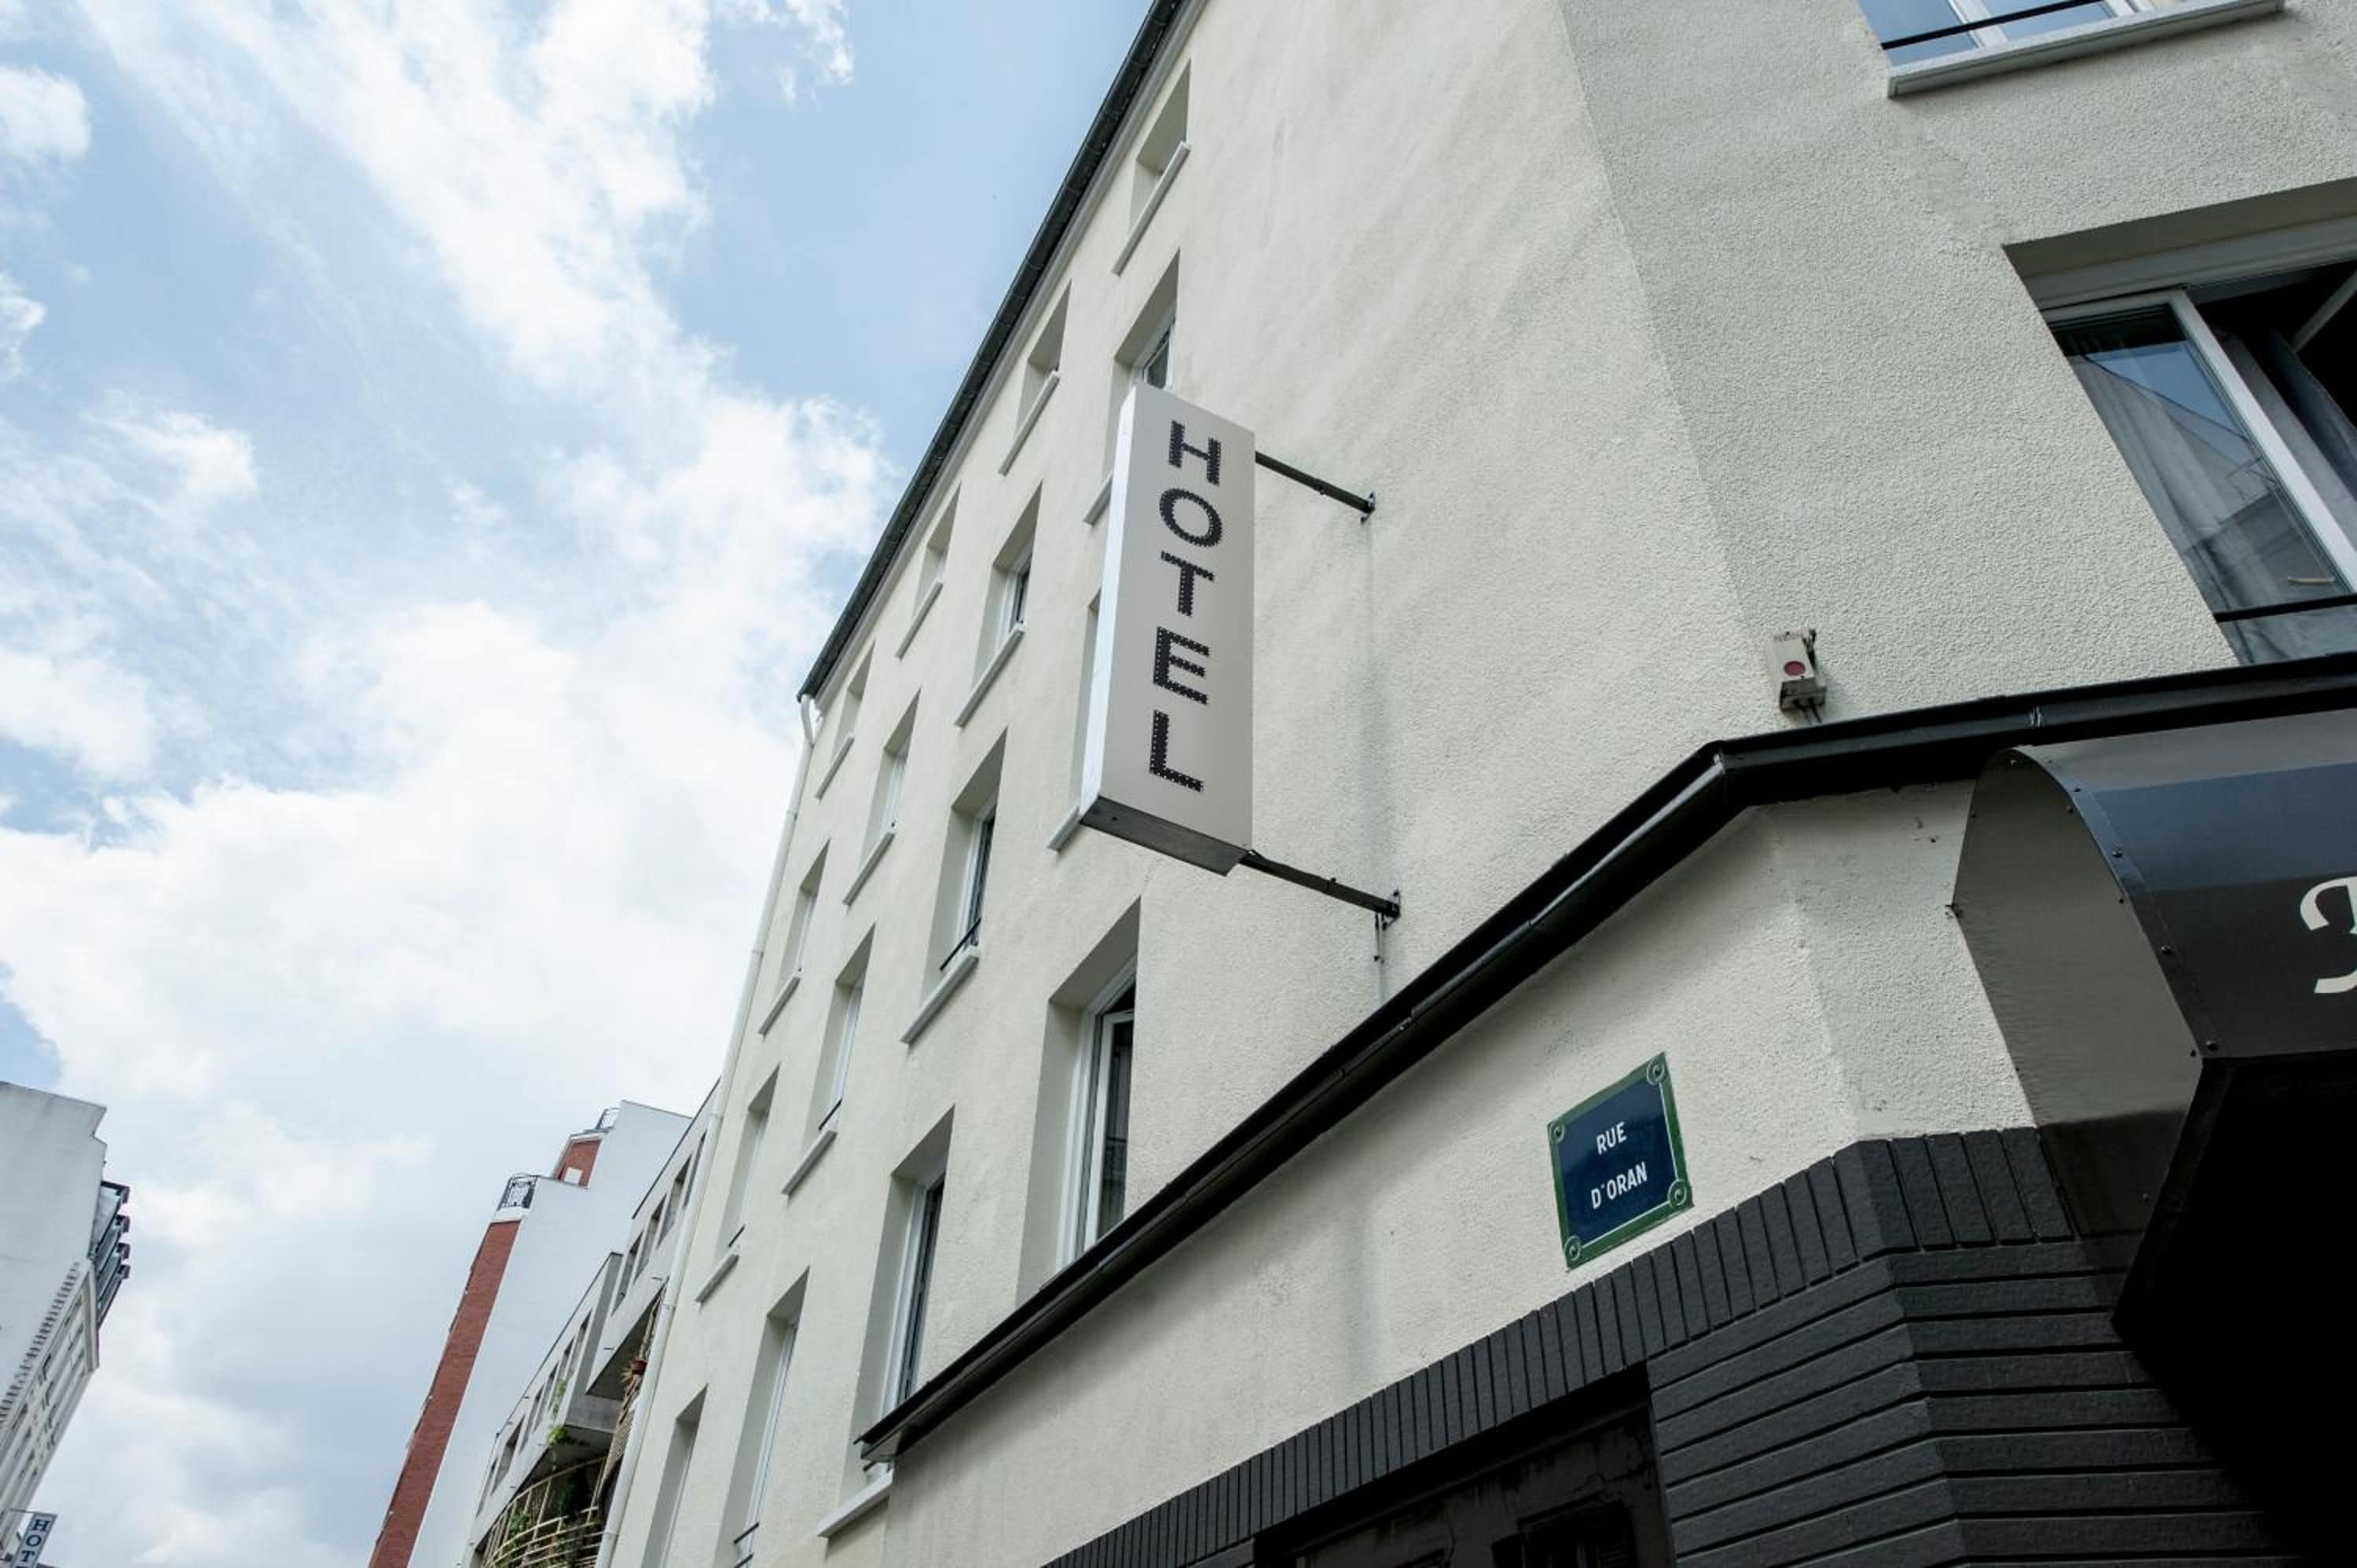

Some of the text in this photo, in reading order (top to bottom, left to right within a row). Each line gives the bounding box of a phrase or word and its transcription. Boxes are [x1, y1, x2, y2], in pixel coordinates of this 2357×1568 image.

[1149, 420, 1223, 793] HOTEL
[1596, 1122, 1627, 1155] RUE
[1591, 1162, 1648, 1210] D'ORAN
[15, 1519, 51, 1568] HOT
